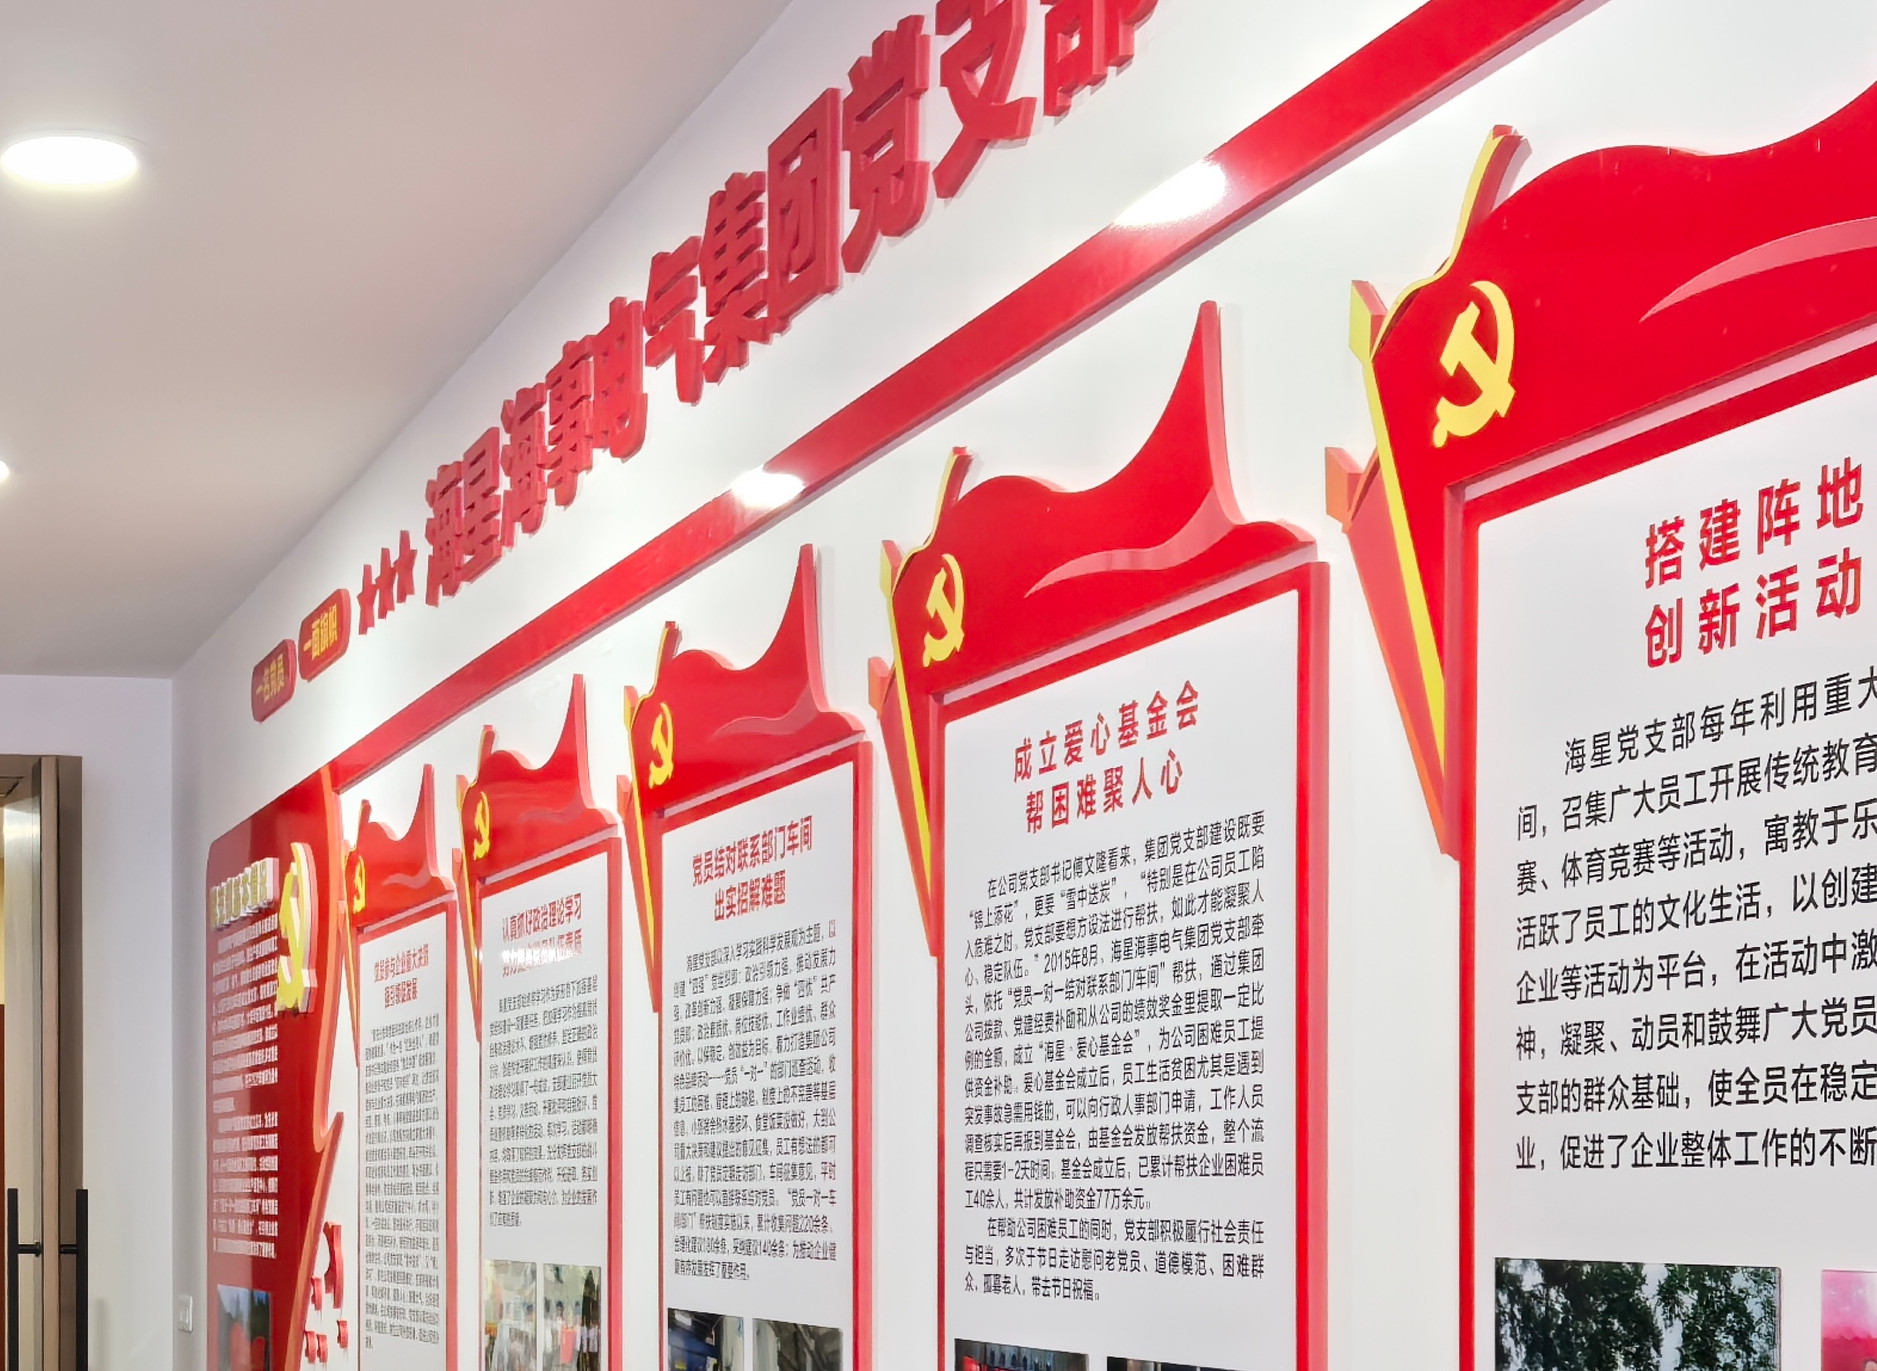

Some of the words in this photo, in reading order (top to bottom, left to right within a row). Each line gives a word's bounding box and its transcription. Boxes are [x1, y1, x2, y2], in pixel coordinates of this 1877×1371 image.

[1644, 456, 1864, 590] 搭建阵地
[1644, 547, 1864, 668] 创新活动
[1014, 679, 1199, 783] 成立爱心基金会
[1564, 665, 1877, 776] 海星党支部每年利用重大
[1026, 748, 1184, 834] 帮困难聚人心
[1516, 733, 1877, 841] 间，召集广大员工开展传统教育
[693, 815, 813, 887] 党员结对联系部门车间
[1516, 797, 1877, 896] 赛、体育竞赛等活动，寓教于乐
[1516, 862, 1877, 951] 活跃了员工的文化生活，以创建
[1516, 927, 1877, 1006] 企业等活动为平台，在活动中激
[1516, 995, 1877, 1061] 神，凝聚、动员和鼓舞广大党员
[1516, 1059, 1877, 1116] 支部的群众基础，使全员在稳定
[1516, 1124, 1877, 1171] 业，促进了企业整体工作的不断
